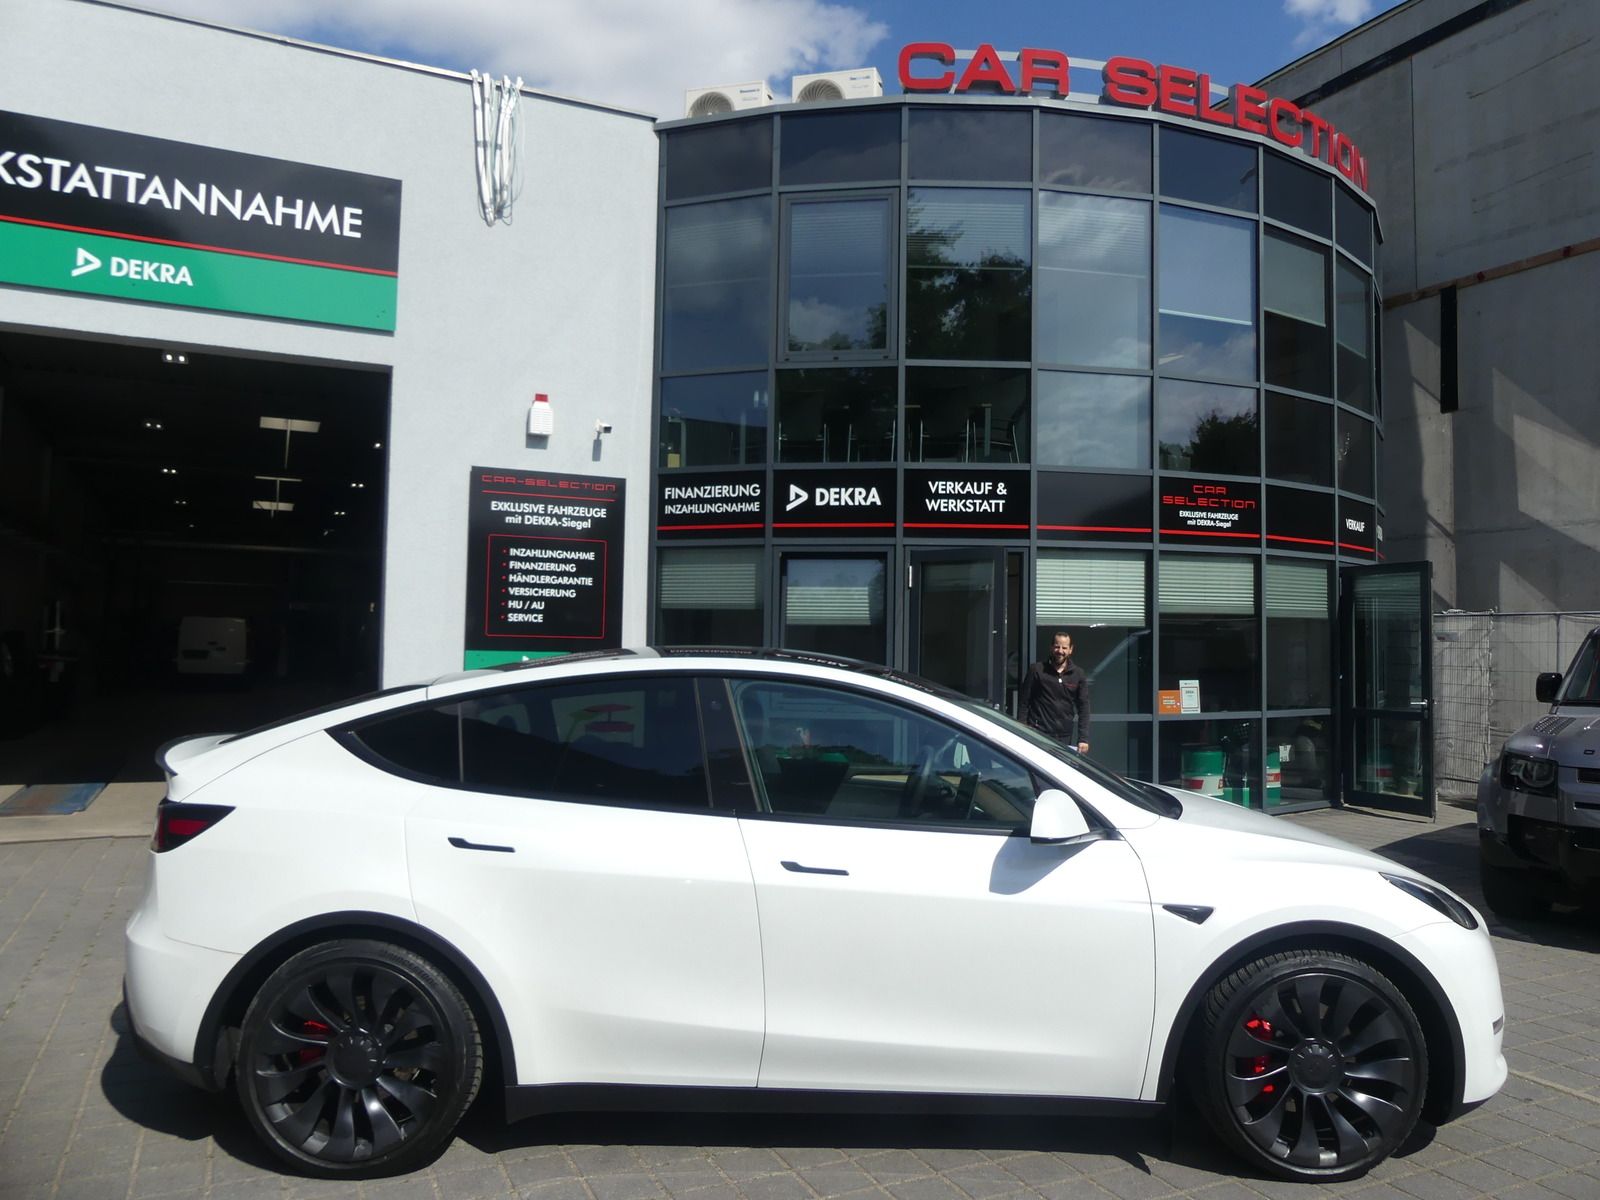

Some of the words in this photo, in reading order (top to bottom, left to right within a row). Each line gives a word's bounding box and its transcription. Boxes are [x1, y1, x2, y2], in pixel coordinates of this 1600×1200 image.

[898, 43, 1070, 98] CAR
[1104, 56, 1368, 193] SELECTION
[0, 150, 364, 240] KSTATTANNAHME
[109, 256, 194, 288] DEKRA
[482, 475, 616, 491] CAR-SELECTION
[927, 481, 993, 494] VERKAUF
[996, 481, 1008, 494] &
[1192, 484, 1227, 495] CAR
[664, 483, 762, 500] FINANZIERUNG
[815, 486, 883, 507] DEKRA
[490, 501, 545, 514] EXKLUSIVE
[547, 505, 607, 518] FAHRZEUGE
[664, 501, 761, 516] INZAHLUNGNAHME
[925, 498, 1007, 514] WERKSTATT
[1162, 495, 1256, 510] SELECTION
[505, 515, 522, 525] mit
[524, 515, 592, 530] DEKRA-Siegel
[1179, 510, 1207, 519] EXKLUSIVE
[1208, 512, 1239, 521] FAHRZEUGE
[1345, 518, 1365, 532] VERKAUF
[509, 548, 596, 560] INZAHLUNGNAHME
[509, 561, 577, 572] FINANZIERUNG
[508, 573, 594, 586] HÄNDLERGARANTIE
[508, 587, 577, 598] VERSICHERUNG
[508, 600, 523, 609] HU
[531, 601, 545, 610] AU
[507, 613, 544, 622] SERVICE
